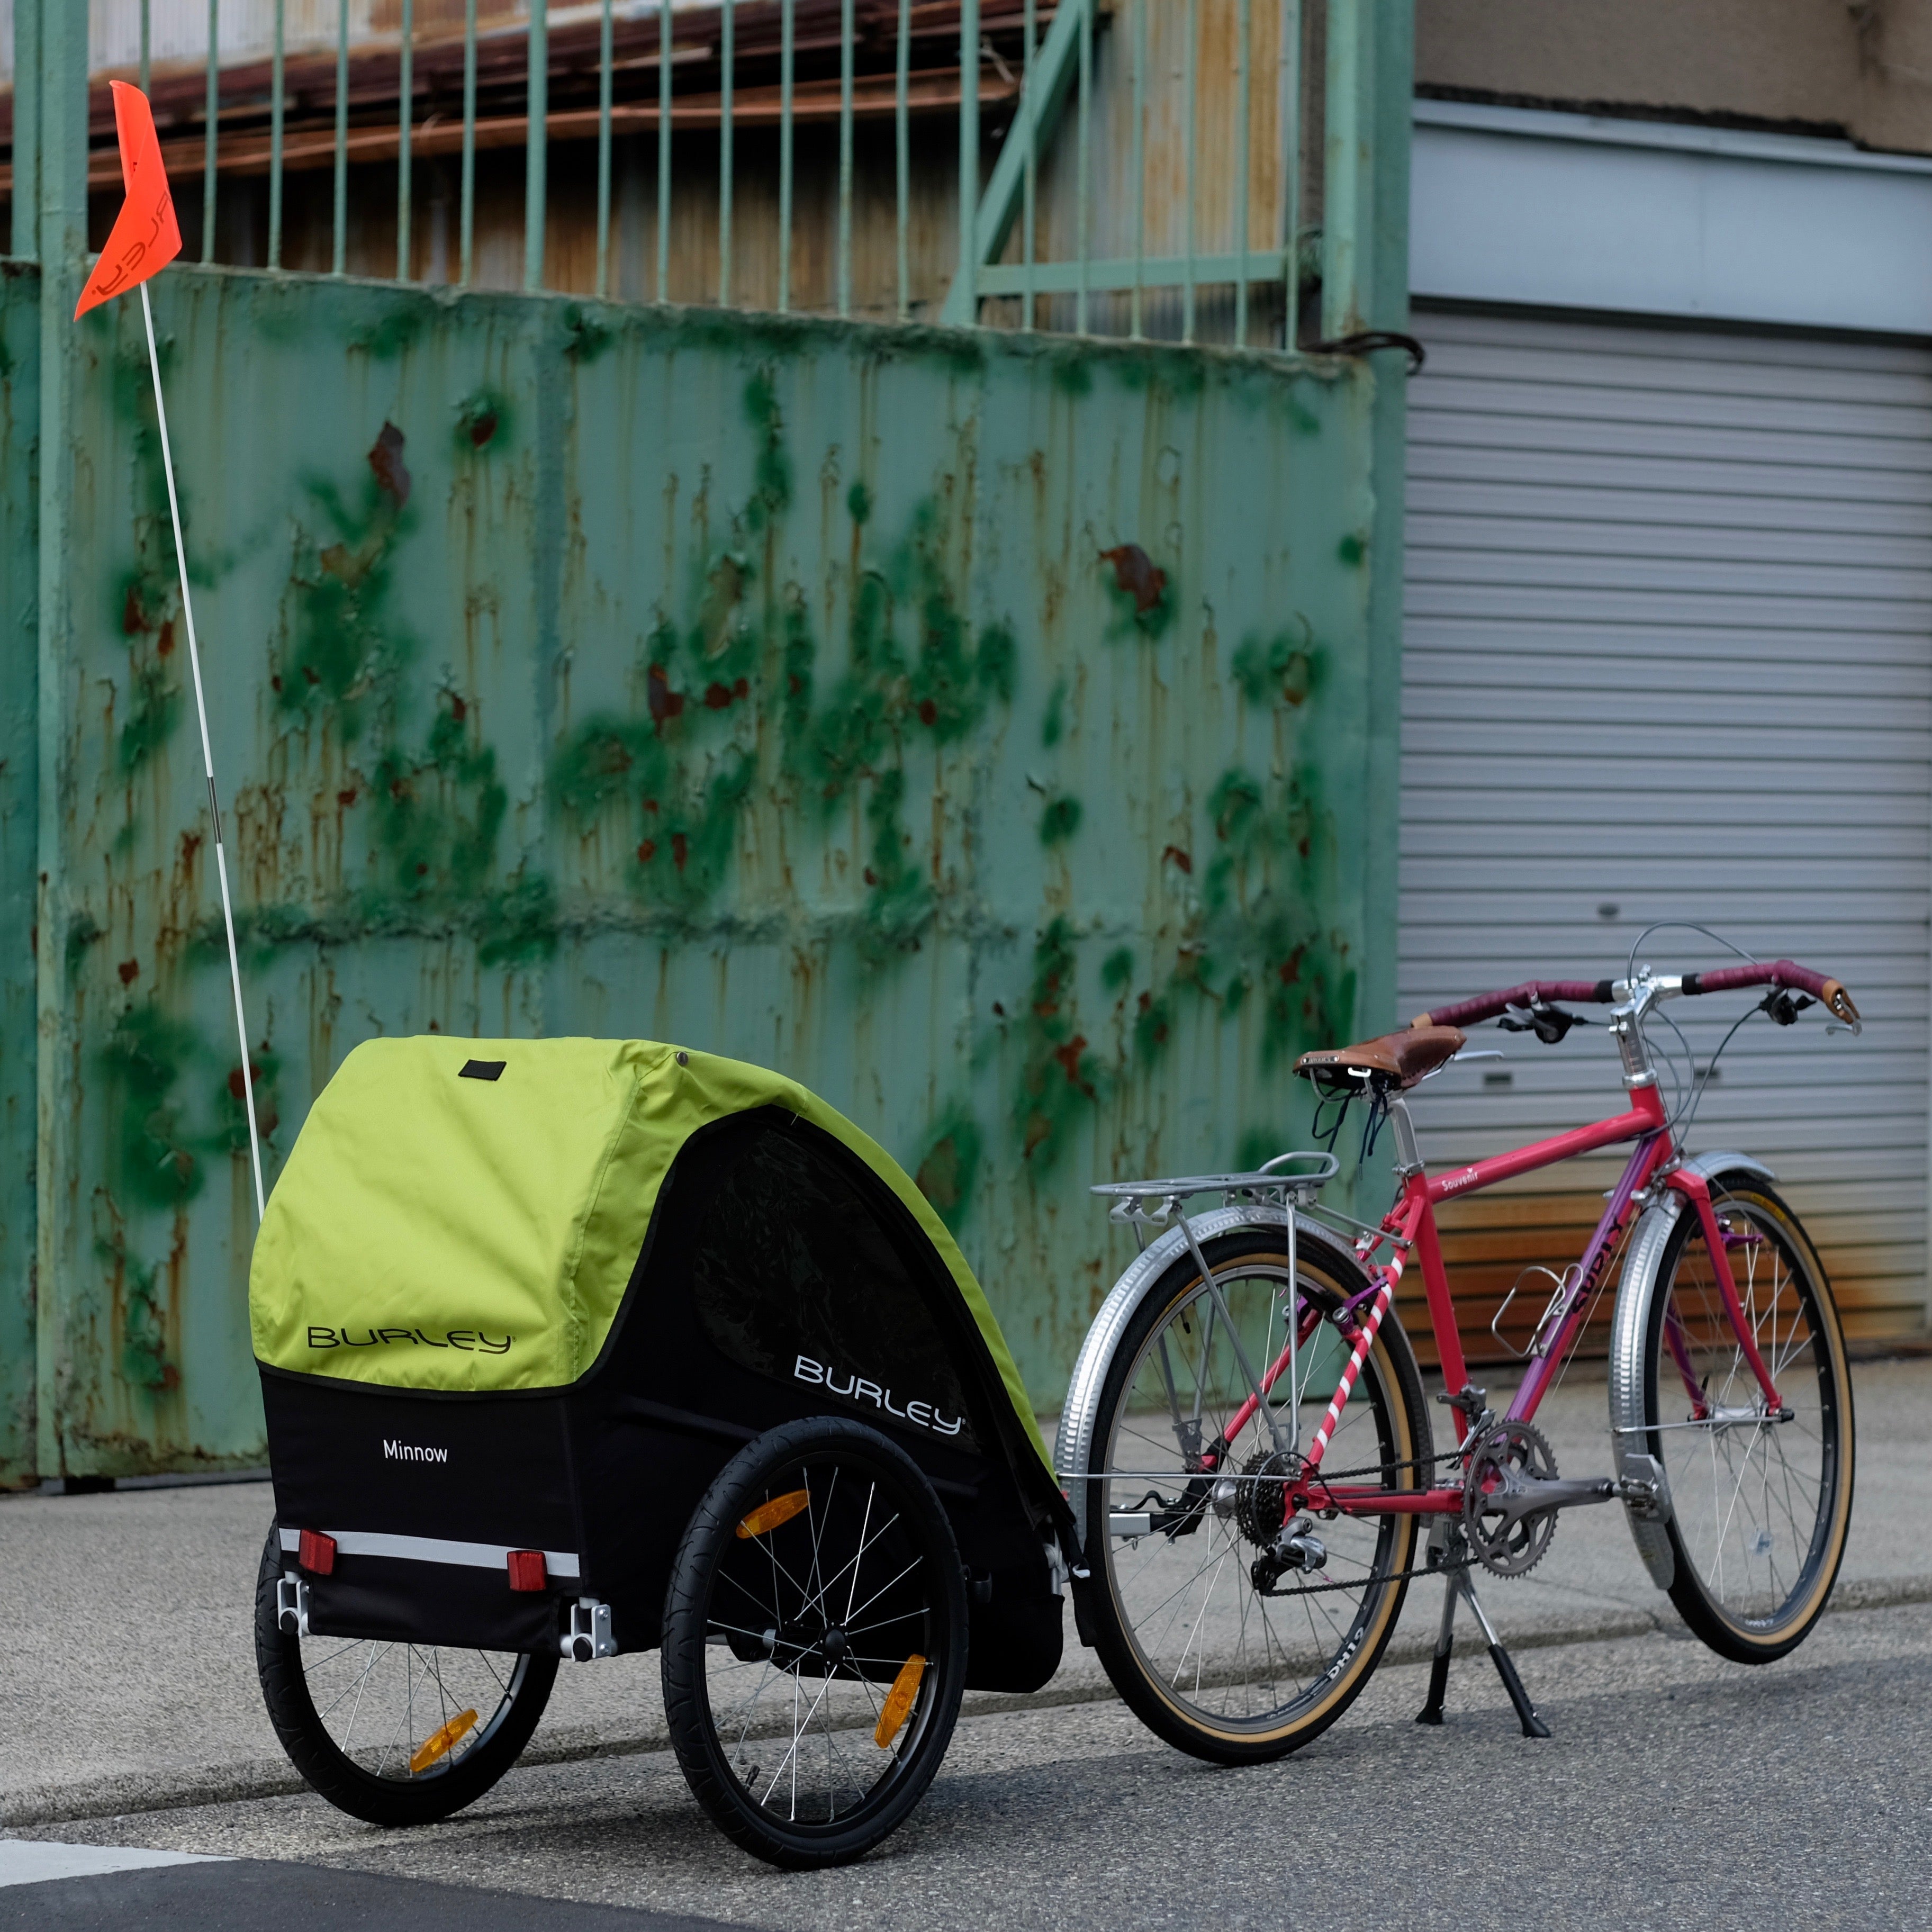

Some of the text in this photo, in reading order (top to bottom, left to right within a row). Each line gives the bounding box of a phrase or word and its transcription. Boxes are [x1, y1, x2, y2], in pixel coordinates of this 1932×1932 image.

[1441, 1168, 1478, 1191] Souvenir
[308, 1326, 511, 1355] BURLEY
[795, 1355, 962, 1435] BURLEY
[383, 1439, 448, 1462] Minnow
